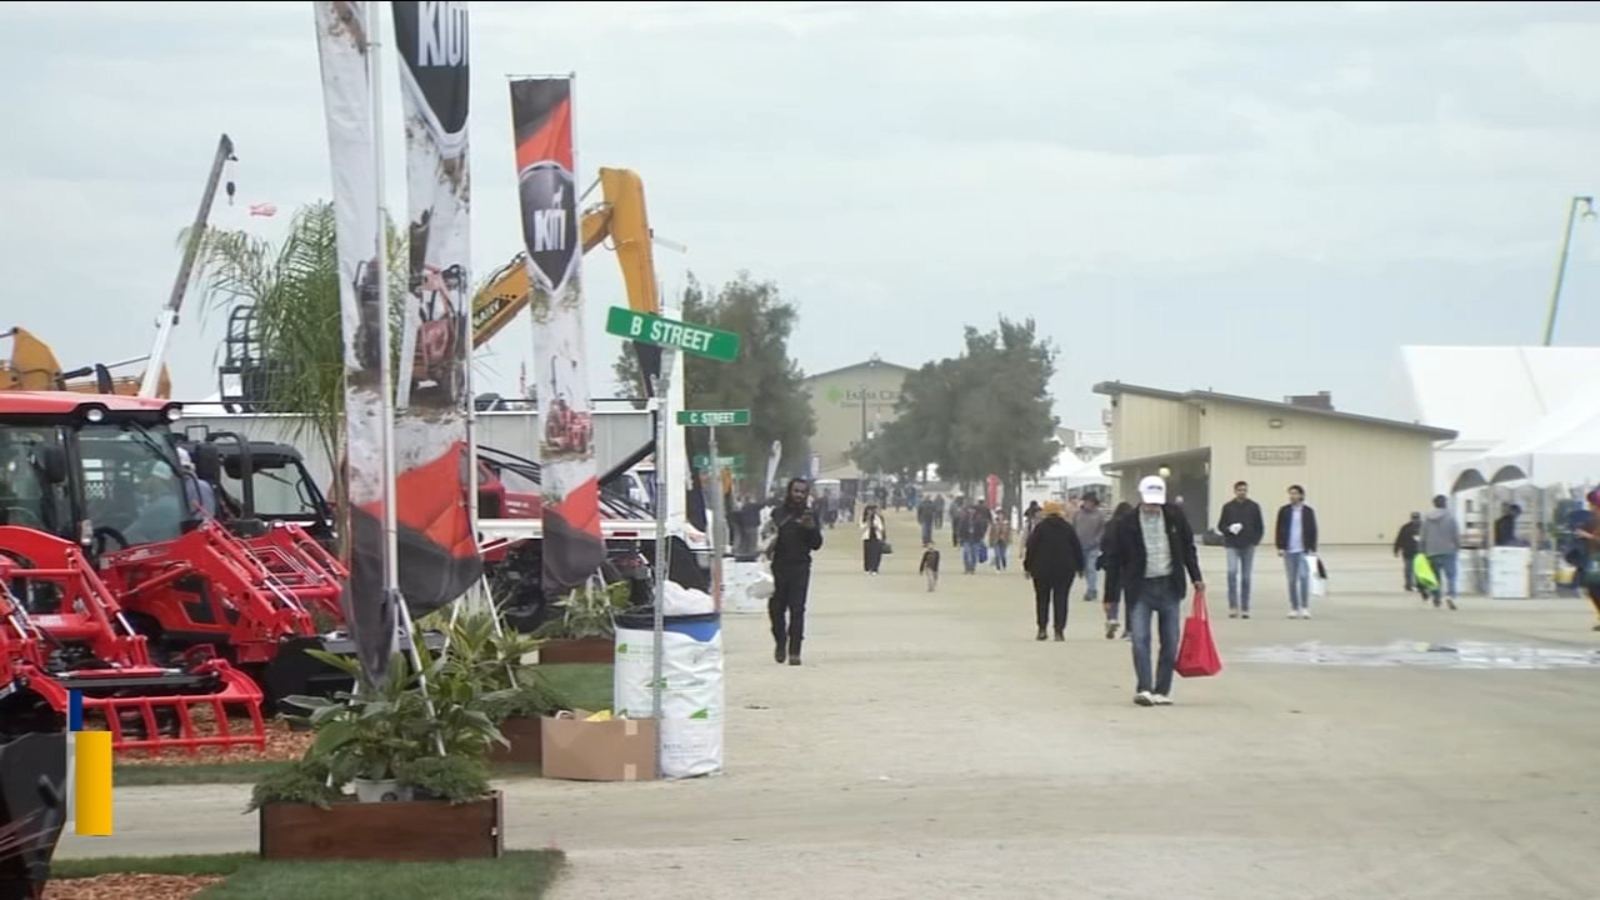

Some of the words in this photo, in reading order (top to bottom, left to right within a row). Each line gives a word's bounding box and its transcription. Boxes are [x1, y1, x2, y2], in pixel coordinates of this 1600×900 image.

[630, 315, 643, 336] B
[650, 320, 714, 352] STREET
[690, 412, 698, 423] C
[701, 412, 735, 423] STREET
